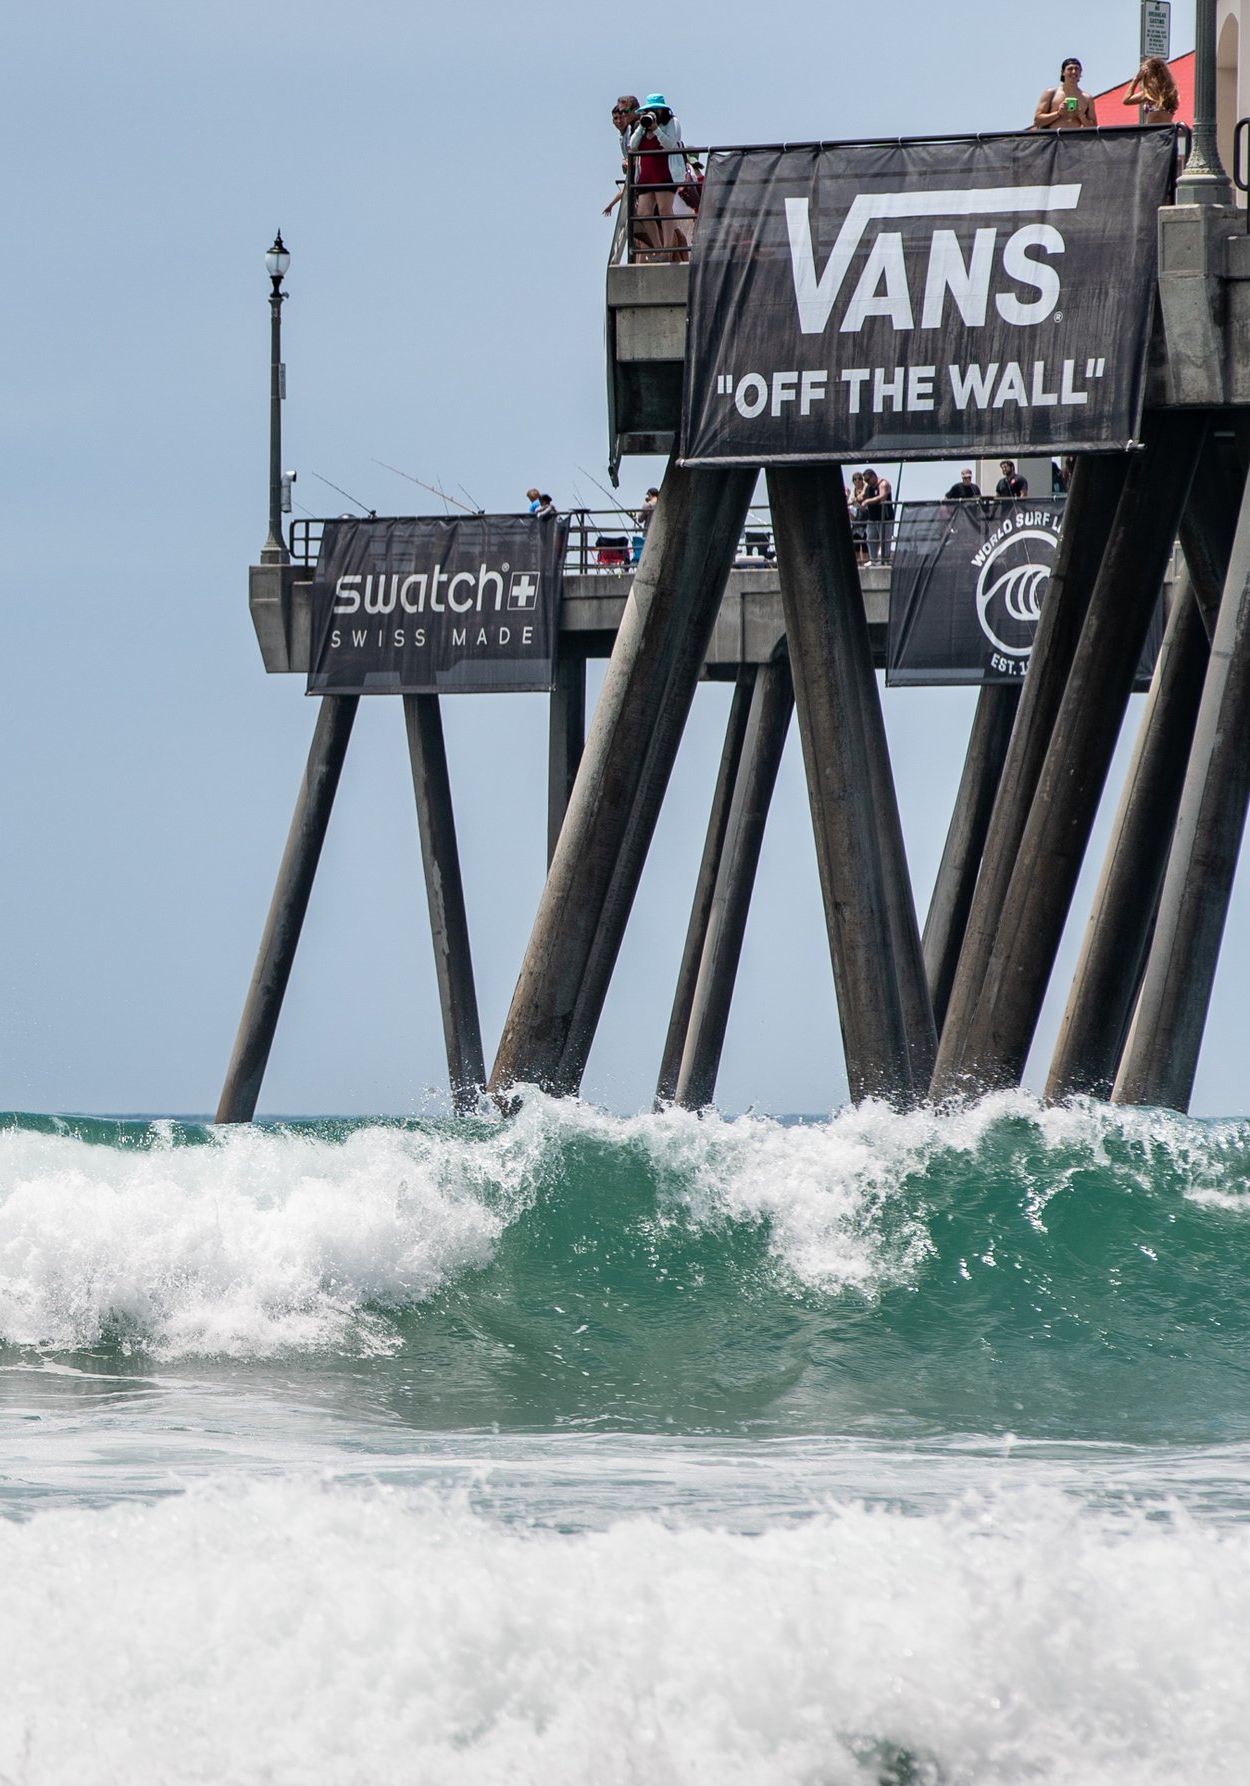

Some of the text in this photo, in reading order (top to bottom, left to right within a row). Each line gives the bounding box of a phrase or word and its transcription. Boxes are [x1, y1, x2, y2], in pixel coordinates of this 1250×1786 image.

[784, 183, 1082, 334] VANS
[717, 357, 1106, 419] "OFF THE WALL"
[970, 518, 1013, 568] WORLD
[1015, 511, 1051, 528] SURF
[333, 563, 504, 615] swatch
[330, 626, 534, 649] SWISS MADE
[990, 652, 1017, 676] EST.
